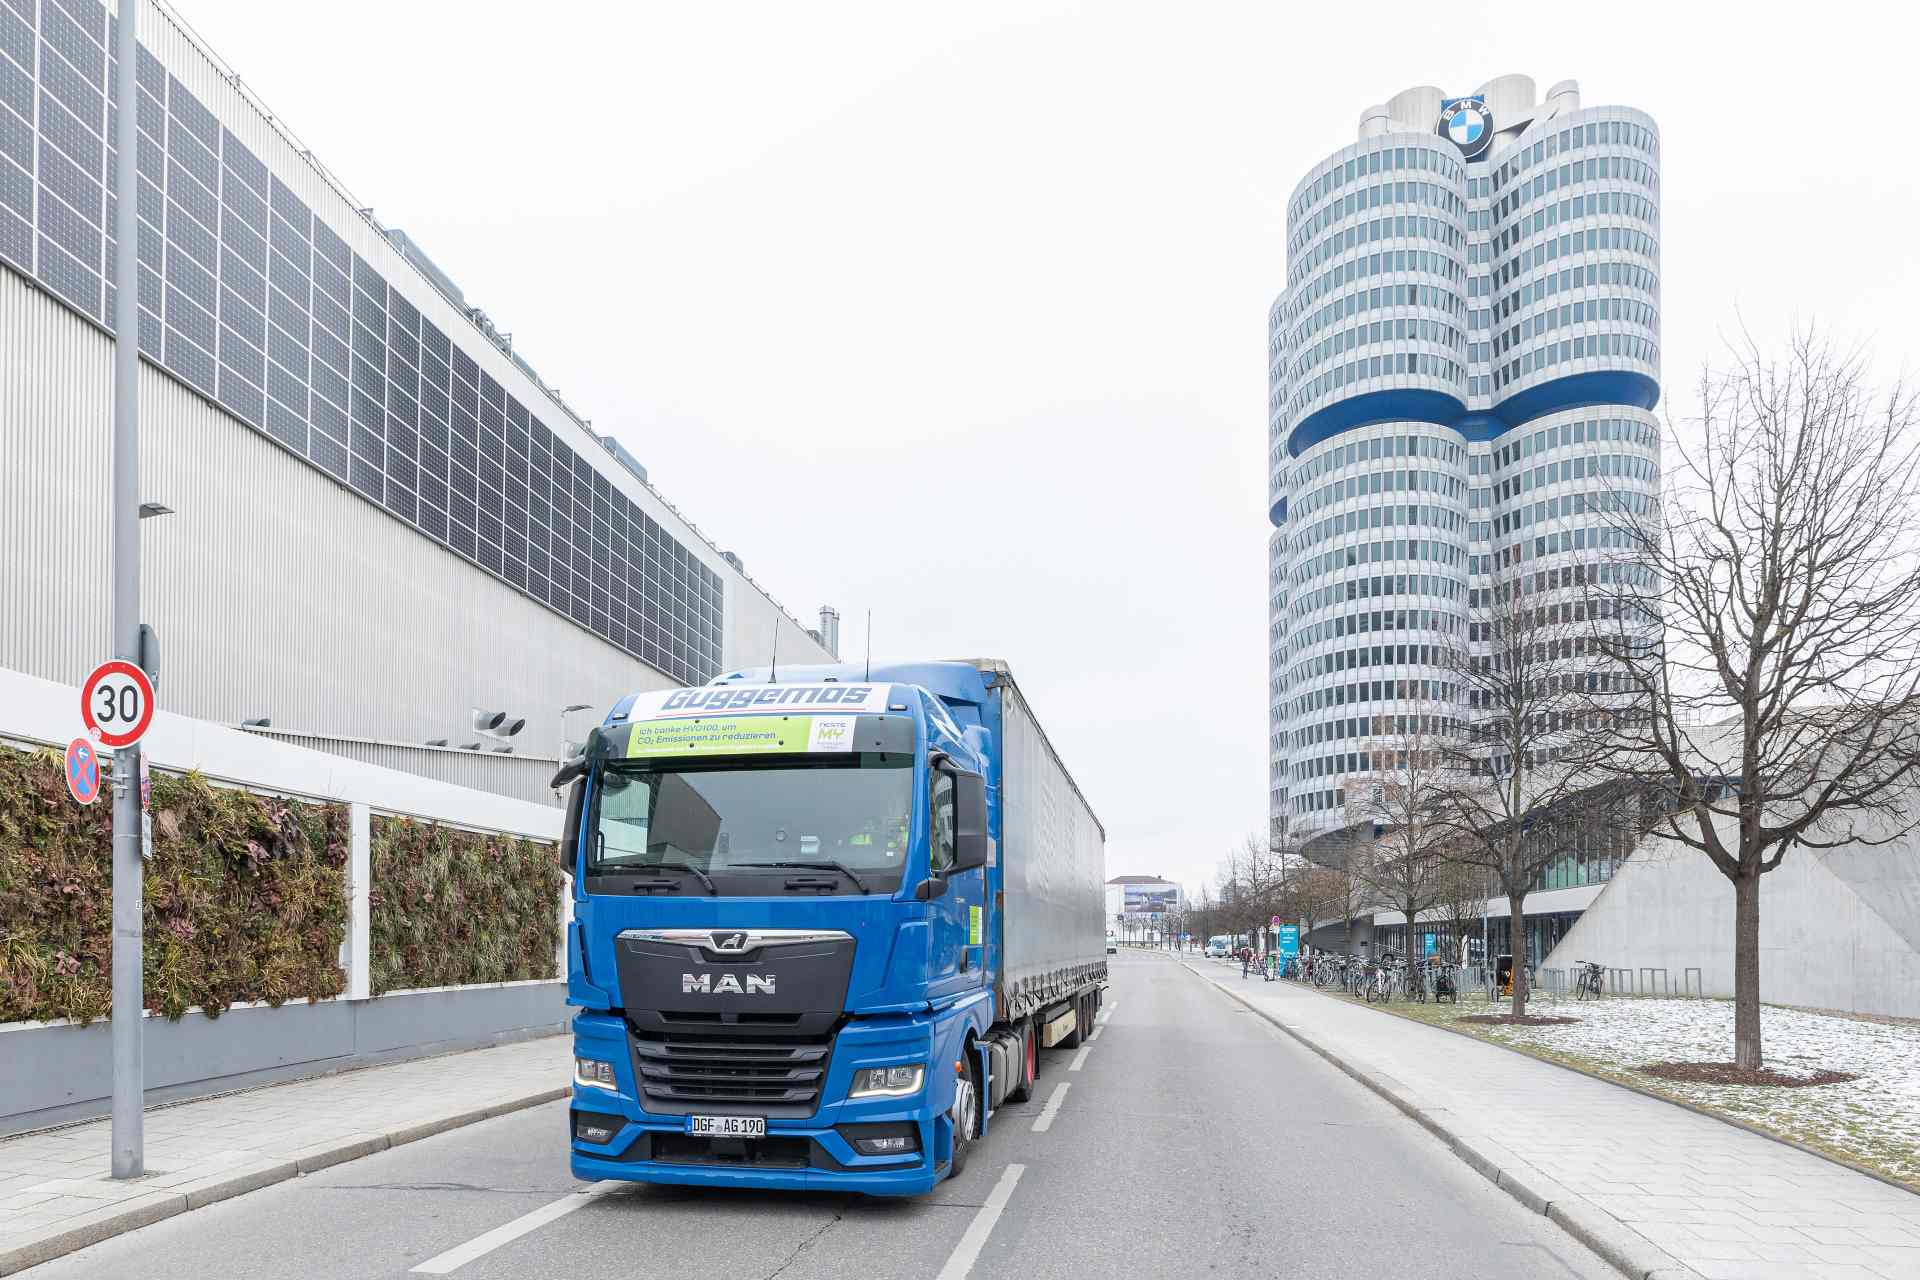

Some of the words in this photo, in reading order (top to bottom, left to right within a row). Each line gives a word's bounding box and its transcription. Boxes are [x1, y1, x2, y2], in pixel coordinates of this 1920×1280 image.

[1443, 101, 1489, 120] BMW
[97, 685, 138, 723] 30
[660, 687, 872, 710] Guggemos
[654, 725, 681, 734] tanke
[656, 734, 708, 744] Emissionen
[682, 973, 776, 994] MAN
[693, 1118, 715, 1132] DGF
[724, 1118, 738, 1133] AG
[741, 1119, 763, 1133] 190
